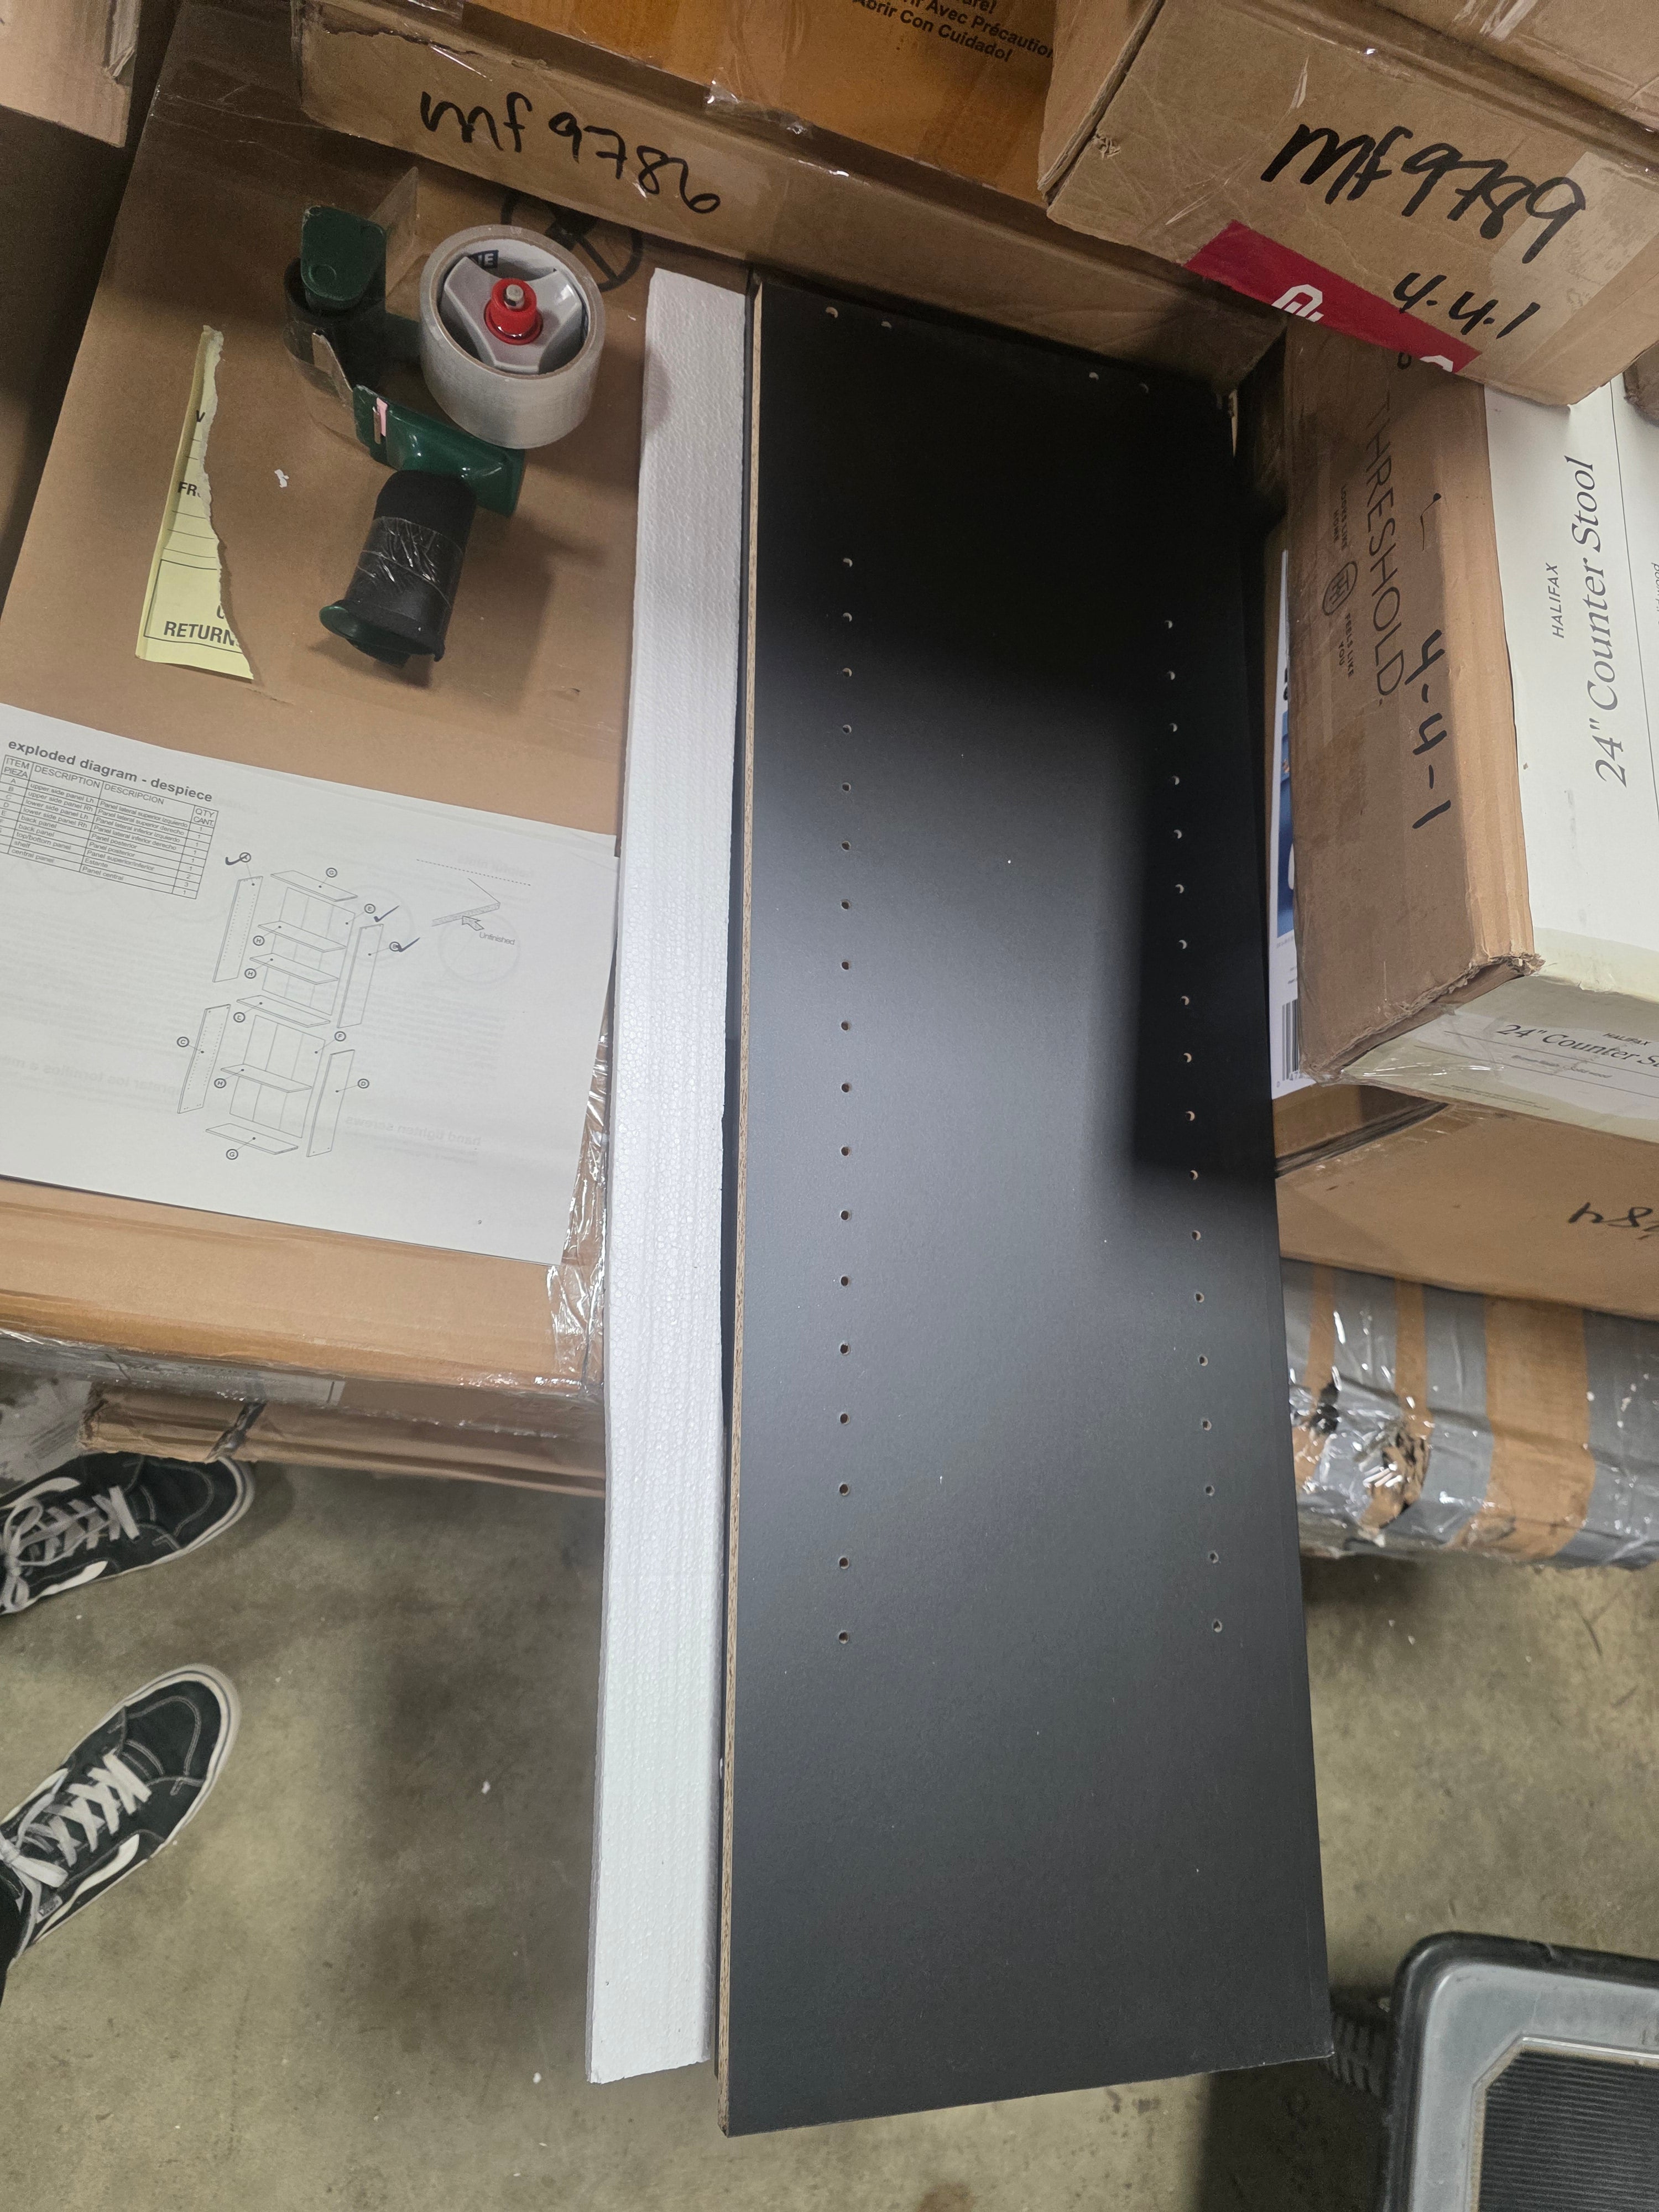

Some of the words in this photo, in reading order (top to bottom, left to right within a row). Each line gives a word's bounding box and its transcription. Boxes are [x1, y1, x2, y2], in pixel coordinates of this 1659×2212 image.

[925, 0, 968, 24] Avec
[900, 10, 934, 32] Con
[938, 24, 1013, 62] Cuidado!
[178, 481, 201, 498] FR
[1564, 455, 1601, 553] Stool
[1545, 562, 1564, 639] HALIFAX
[164, 620, 239, 646] RETURN
[1345, 613, 1353, 648] FEELS
[1583, 557, 1618, 711] Counter
[1589, 718, 1627, 788] 24"
[4, 767, 28, 778] PIEZA
[6, 758, 30, 769] ITEM
[8, 740, 76, 765] exploded
[80, 759, 138, 782] diagram
[150, 779, 212, 802] despiece
[34, 765, 101, 788] DESCRIPTION
[28, 791, 48, 801] upper
[49, 795, 62, 804] side
[64, 800, 82, 809] panel
[30, 783, 50, 792] upper
[51, 787, 65, 796] side
[66, 791, 85, 801] panel
[104, 784, 164, 805] DESCRIPCION
[23, 807, 41, 816] lower
[43, 811, 56, 820] side
[58, 816, 76, 826] panel
[45, 803, 59, 812] side
[60, 808, 79, 817] panel
[100, 801, 118, 810] Panel
[119, 805, 137, 815] lateral
[138, 810, 161, 821] superior
[195, 808, 215, 818] QTY
[18, 823, 35, 832] back
[36, 827, 55, 837] panel
[21, 815, 36, 823] back
[38, 819, 57, 828] panel
[95, 817, 114, 826] Panel
[114, 821, 133, 831] lateral
[133, 826, 153, 835] inferior
[97, 809, 116, 818] Panel
[117, 813, 134, 822] lateral
[135, 818, 159, 829] superior
[160, 824, 184, 836] derecho
[194, 816, 213, 827] CANT.
[14, 840, 30, 848] shelf
[53, 841, 71, 850] panel
[91, 833, 109, 842] Panel
[110, 838, 137, 849] posterior
[93, 825, 112, 834] Panel
[112, 830, 131, 838] lateral
[131, 834, 152, 844] inferior
[152, 839, 176, 851] derecho
[12, 849, 34, 858] central
[35, 854, 54, 863] panel
[87, 850, 106, 859] Panel
[89, 842, 107, 851] Panel
[108, 847, 135, 858] posterior
[85, 858, 108, 868] Estante
[82, 866, 101, 875] Panel
[102, 871, 124, 881] central
[479, 931, 515, 945] Unfinished
[1542, 1034, 1640, 1060] Counter
